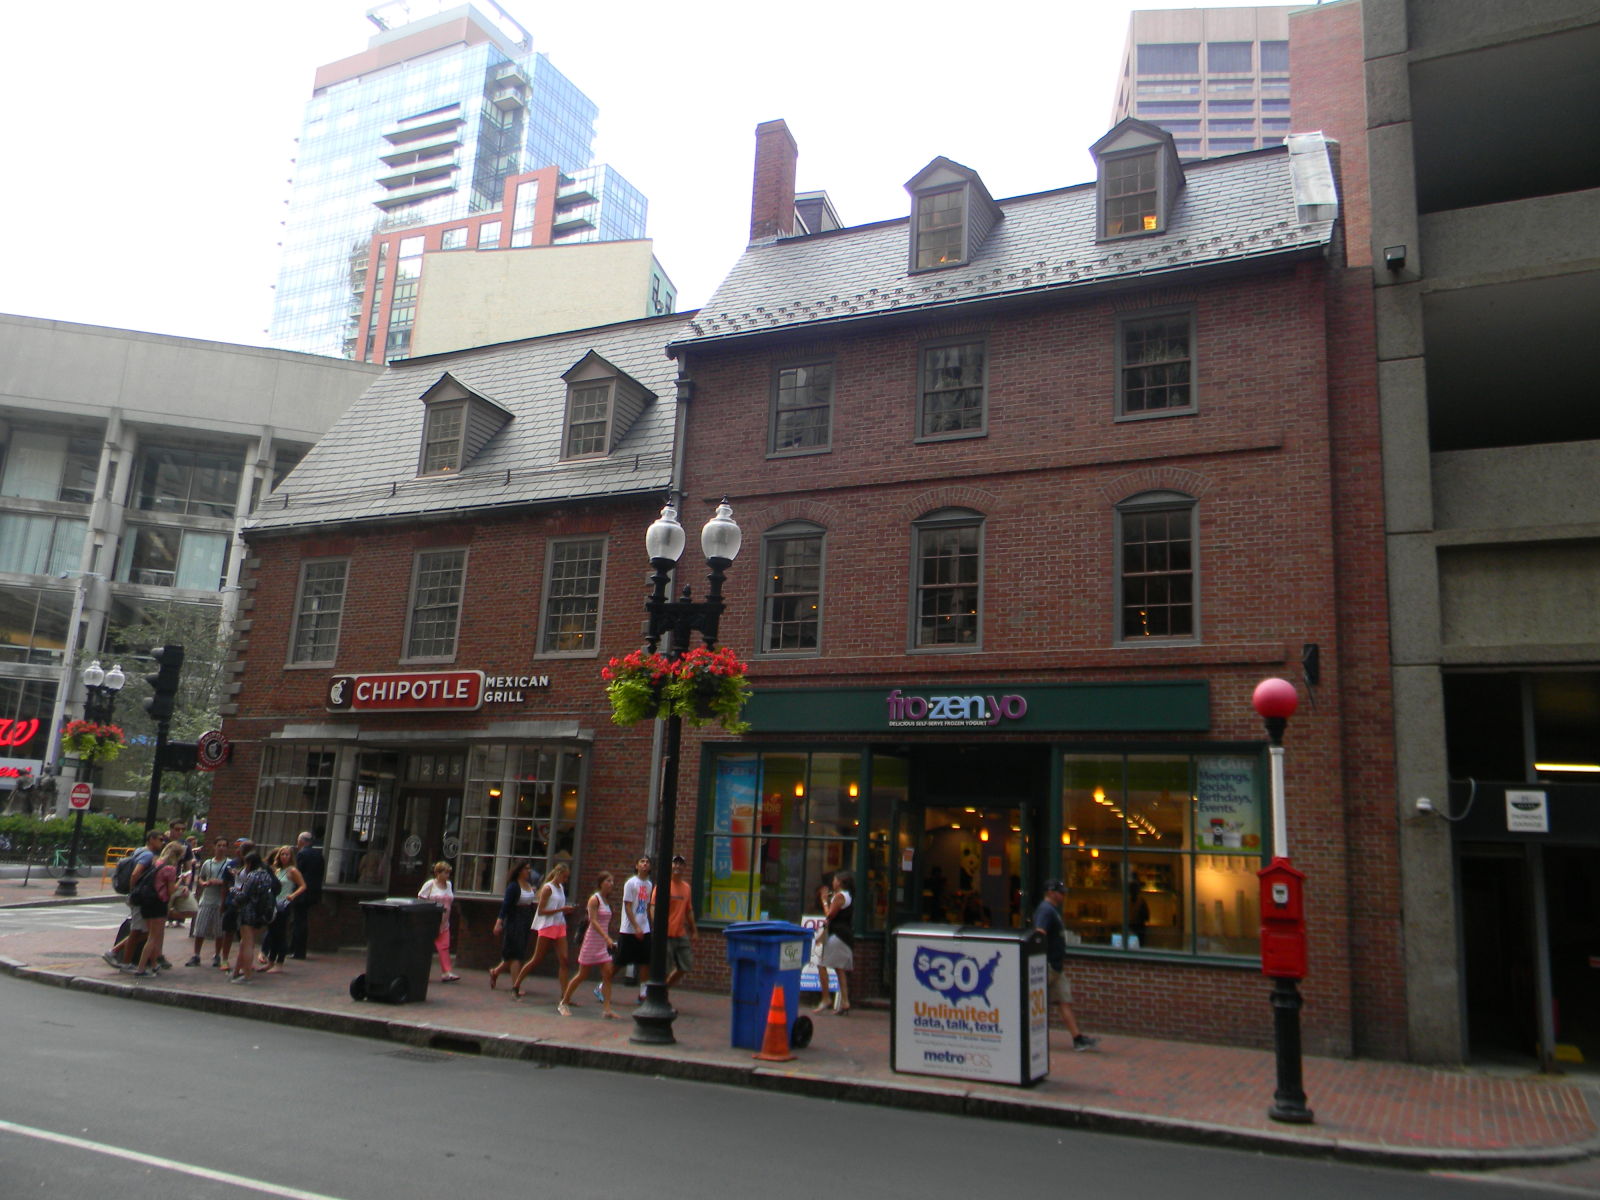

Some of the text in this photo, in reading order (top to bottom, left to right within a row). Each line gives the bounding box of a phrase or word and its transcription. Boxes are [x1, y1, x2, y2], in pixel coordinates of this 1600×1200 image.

[485, 675, 549, 688] MEXICAN
[356, 679, 471, 701] CHIPOTLE
[484, 691, 524, 702] GRILL
[1199, 771, 1250, 784] Meetings,
[1199, 782, 1236, 792] Socials,
[1199, 792, 1252, 805] Birthdays,
[1199, 803, 1237, 813] Events.
[918, 955, 979, 992] $30
[914, 1001, 1000, 1023] Unlimited
[914, 1016, 1003, 1034] data, talk, text.
